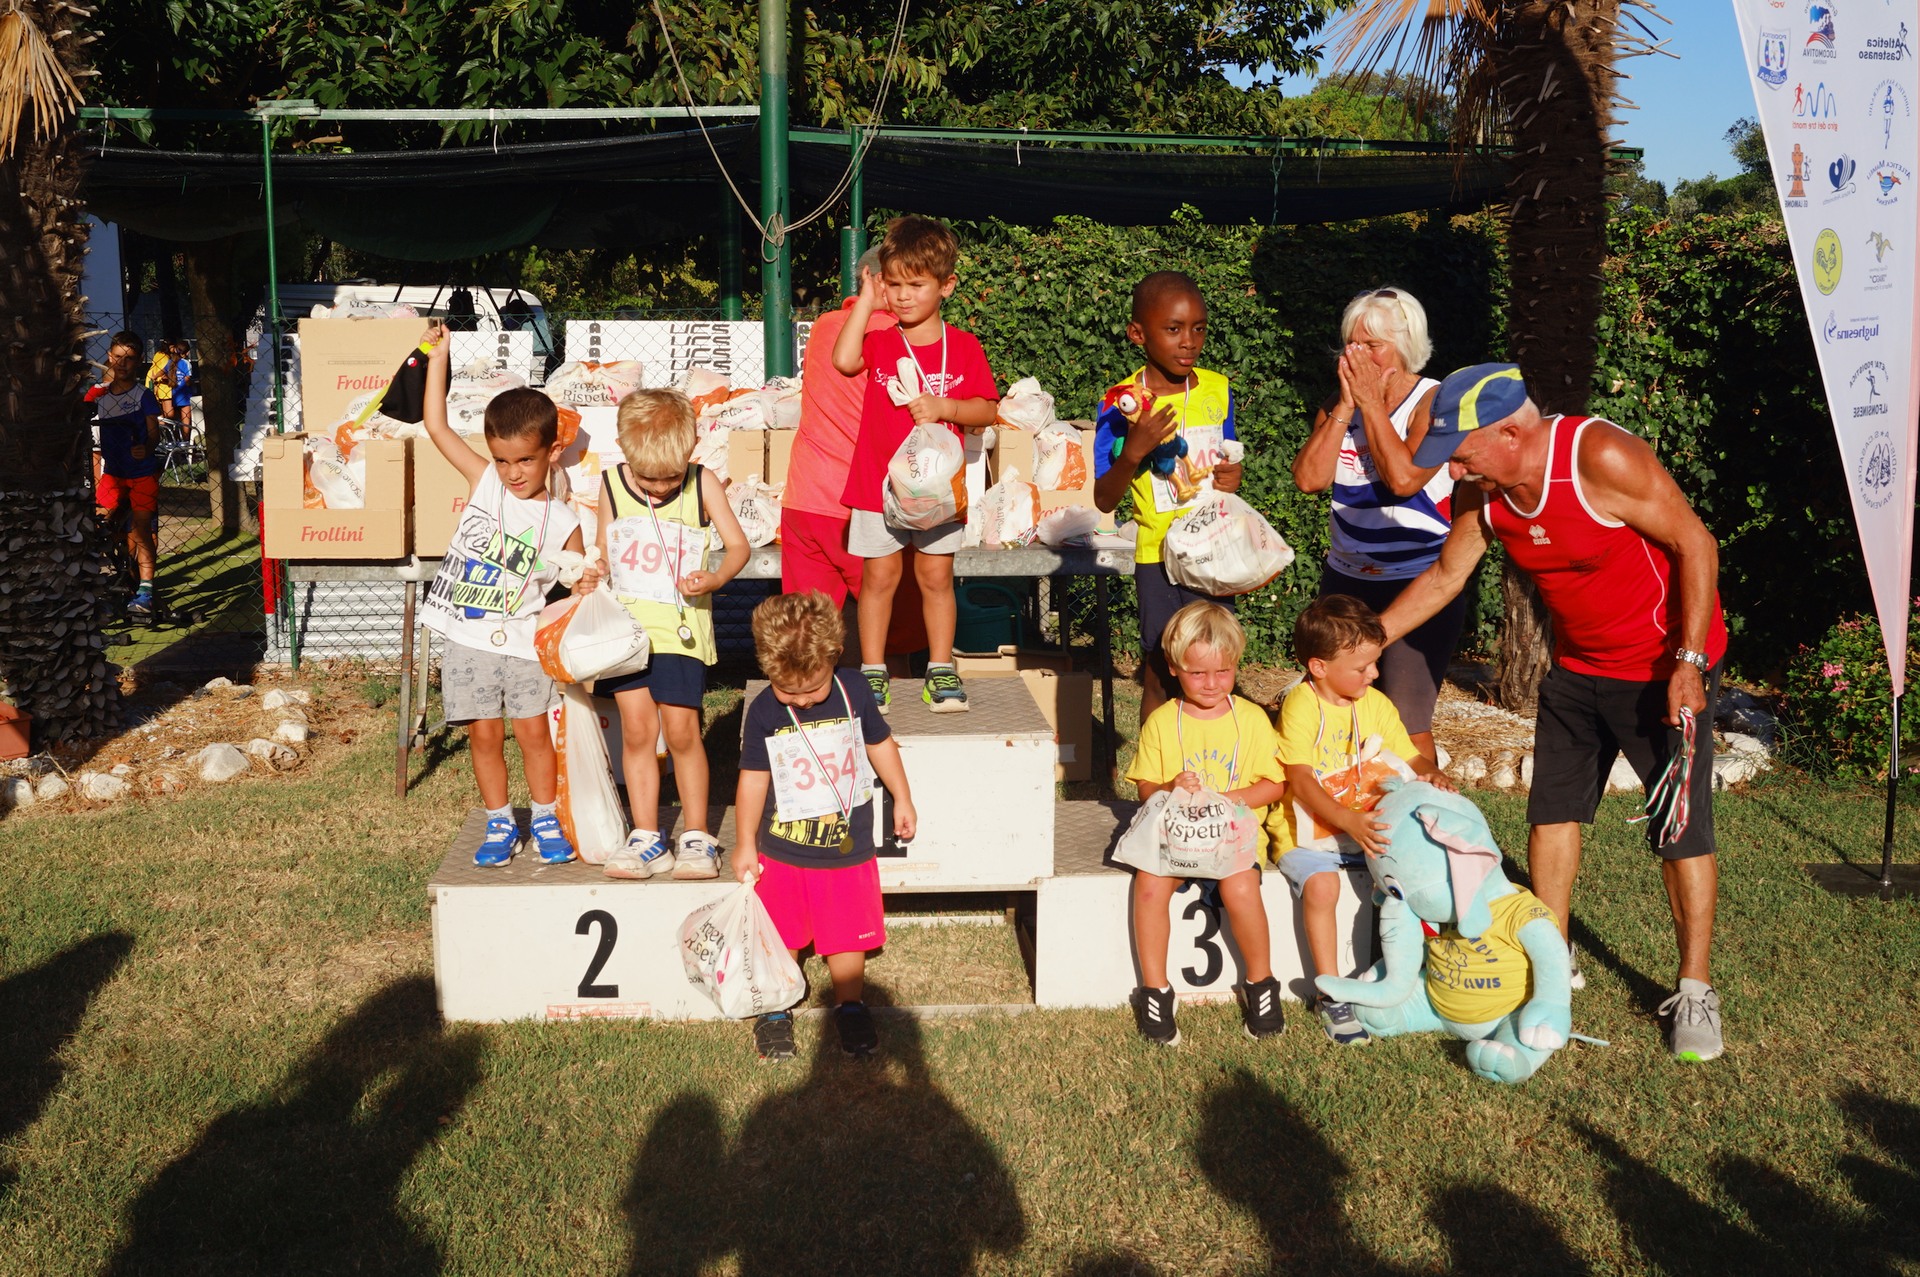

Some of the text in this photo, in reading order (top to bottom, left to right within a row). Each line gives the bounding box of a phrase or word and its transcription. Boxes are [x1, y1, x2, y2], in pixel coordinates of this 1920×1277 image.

[336, 374, 395, 391] Frollin
[906, 449, 921, 480] sone
[300, 525, 365, 542] Frollini
[620, 539, 687, 577] 497
[425, 596, 464, 623] DAYTONA
[791, 747, 859, 791] 354
[1167, 817, 1229, 843] ispett
[1170, 859, 1199, 869] CONAD
[574, 909, 619, 998] 2
[1181, 898, 1223, 987] 3
